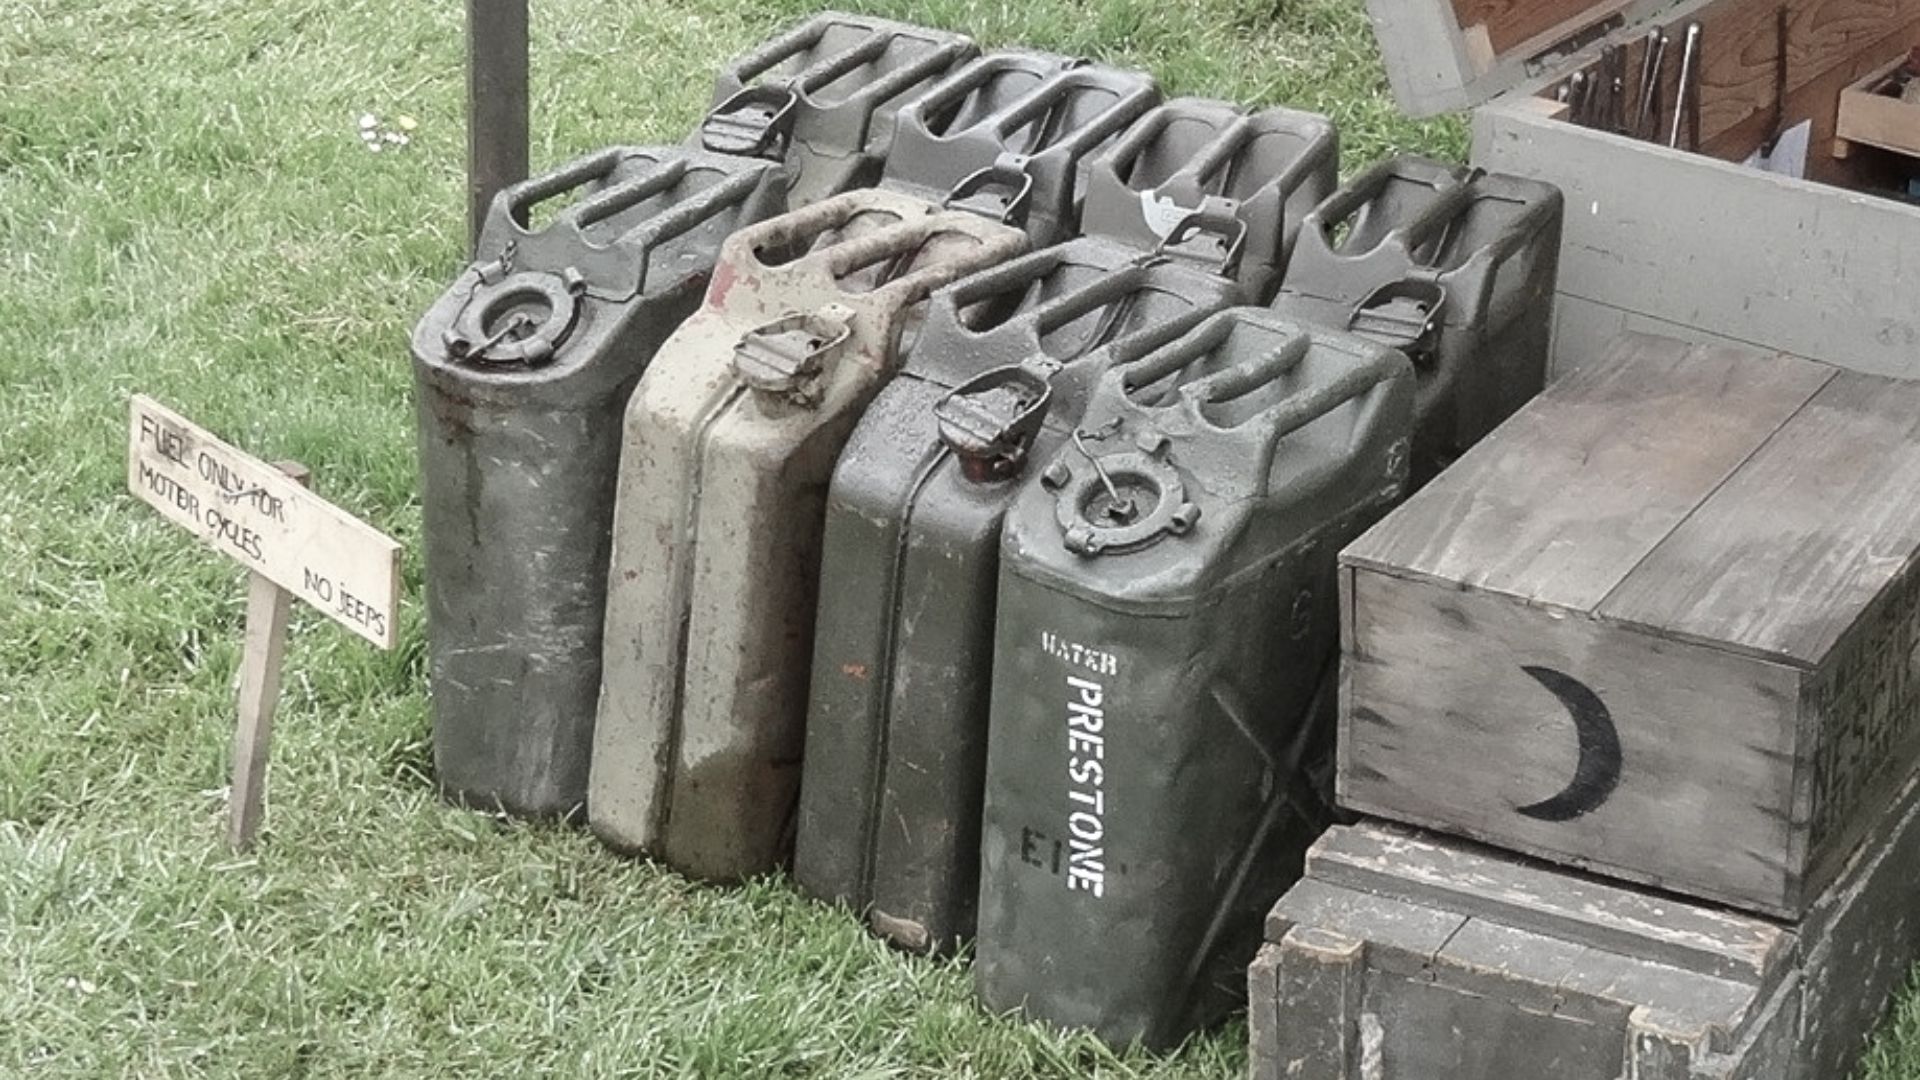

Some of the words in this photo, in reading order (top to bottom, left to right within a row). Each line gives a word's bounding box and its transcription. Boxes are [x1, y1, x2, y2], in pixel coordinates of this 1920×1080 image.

[140, 414, 190, 470] FUEL
[198, 452, 245, 504] ONLY
[252, 482, 284, 522] FOR
[304, 566, 332, 602] NO
[336, 582, 385, 637] JEEPS
[1066, 676, 1104, 897] PRESTONE
